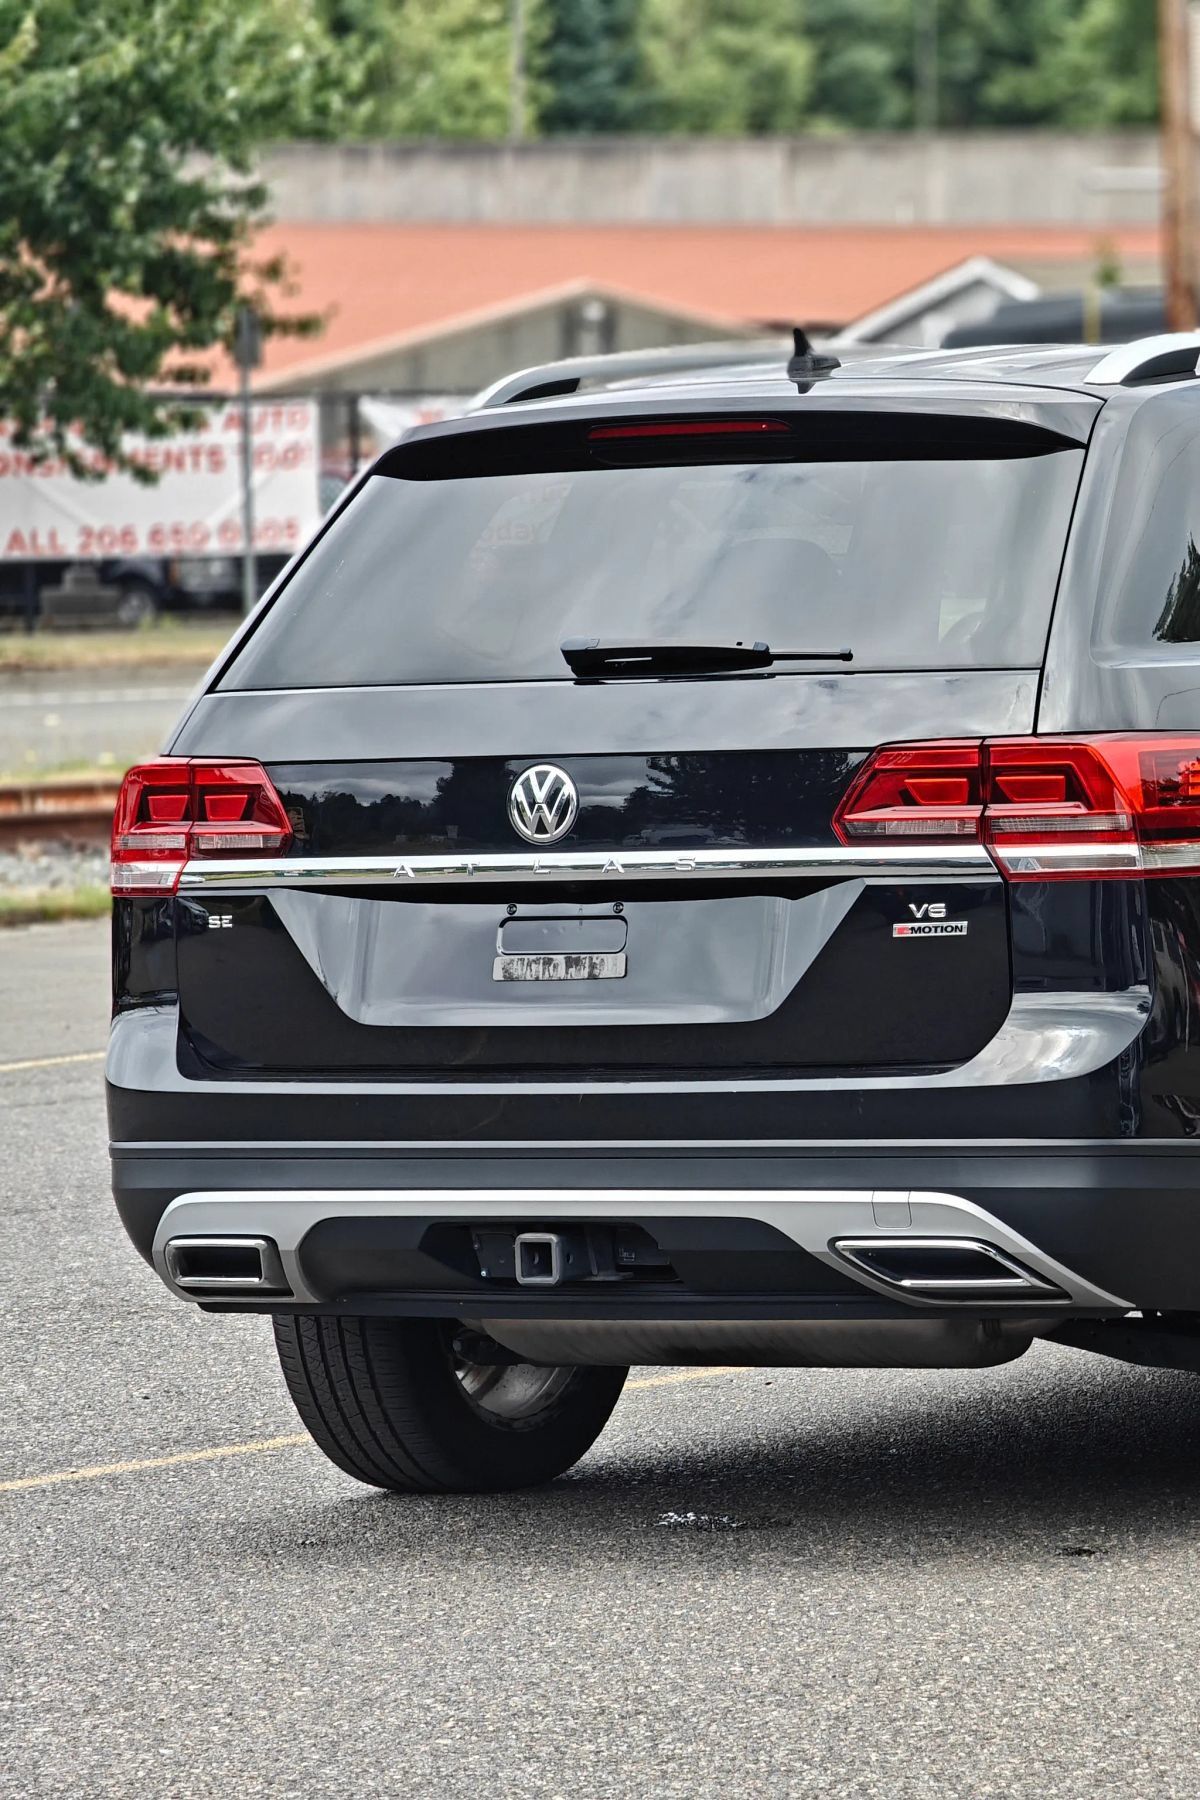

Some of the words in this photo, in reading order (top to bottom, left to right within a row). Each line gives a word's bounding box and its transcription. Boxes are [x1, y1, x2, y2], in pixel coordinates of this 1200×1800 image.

[393, 857, 696, 879] ATLAS
[908, 903, 947, 919] V6
[208, 915, 233, 929] SE
